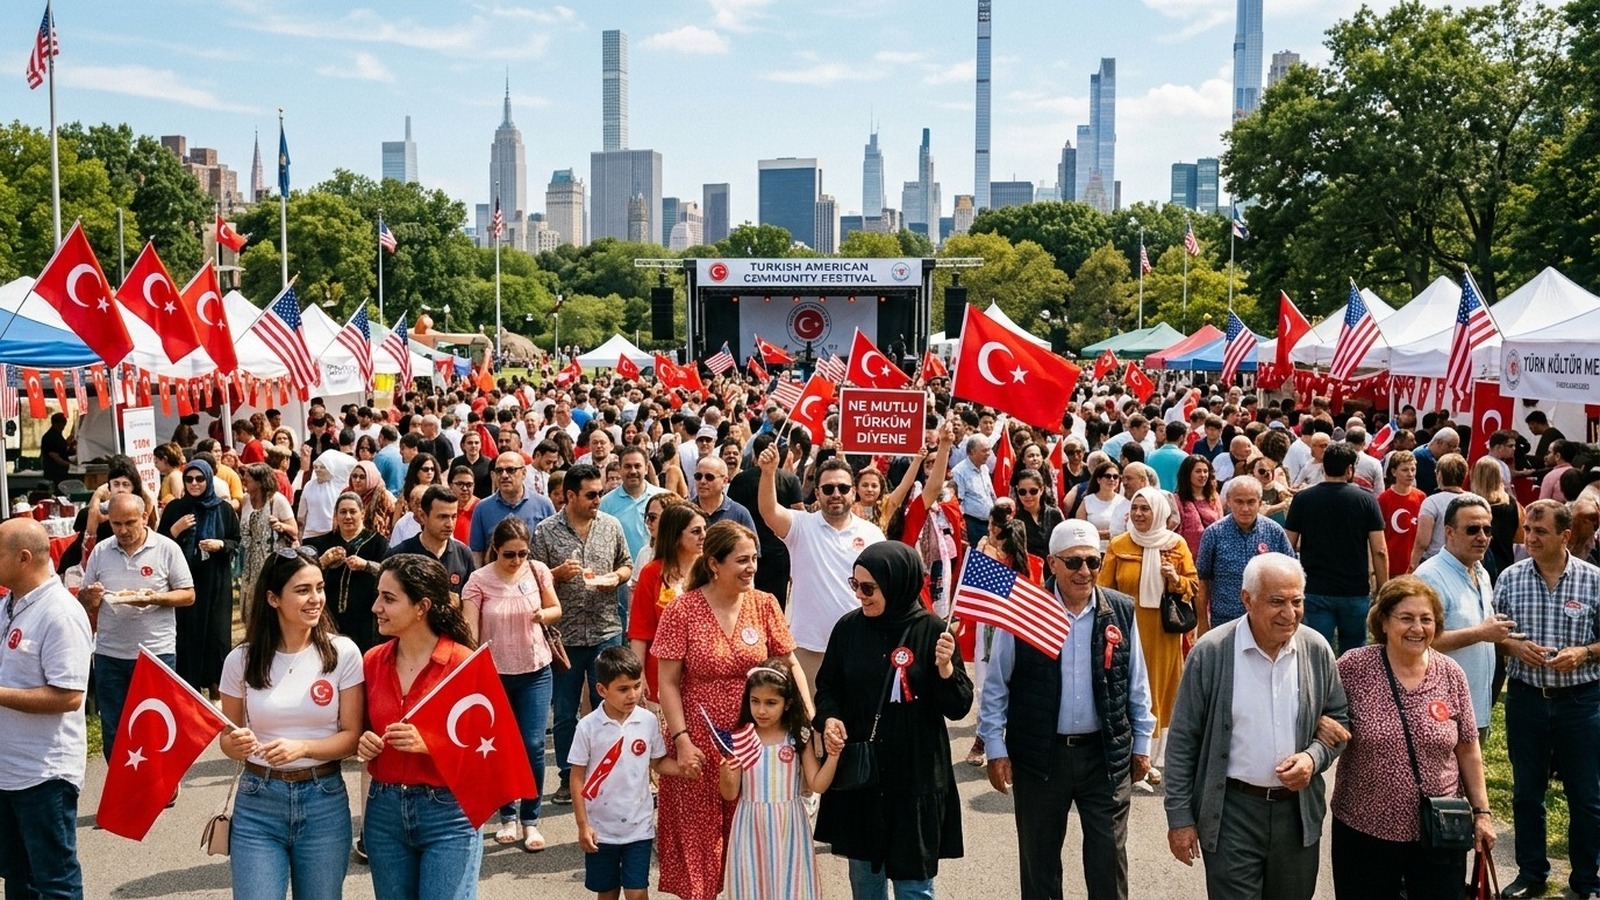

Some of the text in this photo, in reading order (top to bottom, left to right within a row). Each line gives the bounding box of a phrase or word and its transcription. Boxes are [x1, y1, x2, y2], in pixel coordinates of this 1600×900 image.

[750, 262, 869, 272] TURKISH AMERICAN
[1585, 357, 1600, 376] ME
[848, 400, 918, 413] NE MUTLU
